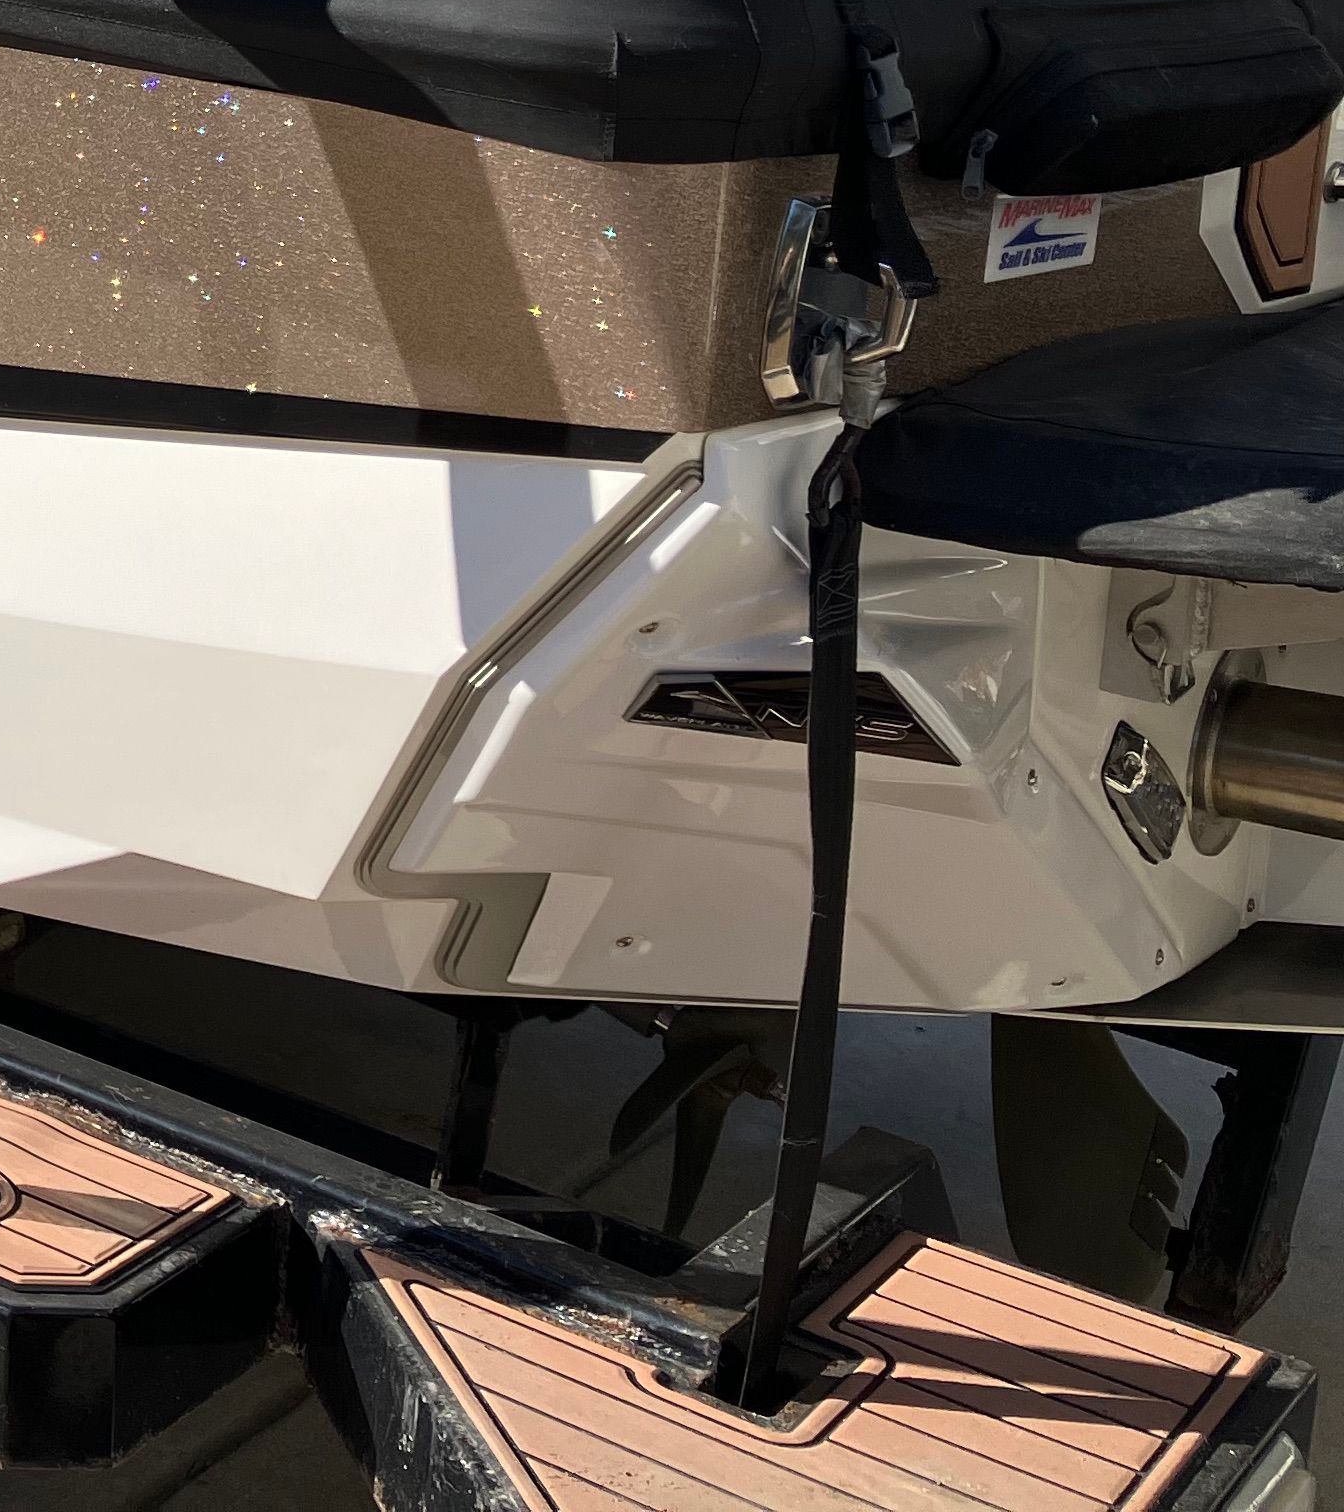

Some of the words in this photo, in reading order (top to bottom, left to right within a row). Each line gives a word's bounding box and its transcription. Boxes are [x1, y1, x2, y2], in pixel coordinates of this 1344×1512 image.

[999, 251, 1023, 270] Sail
[1023, 248, 1032, 266] &
[1032, 246, 1051, 264] Ski
[1050, 242, 1087, 261] Center
